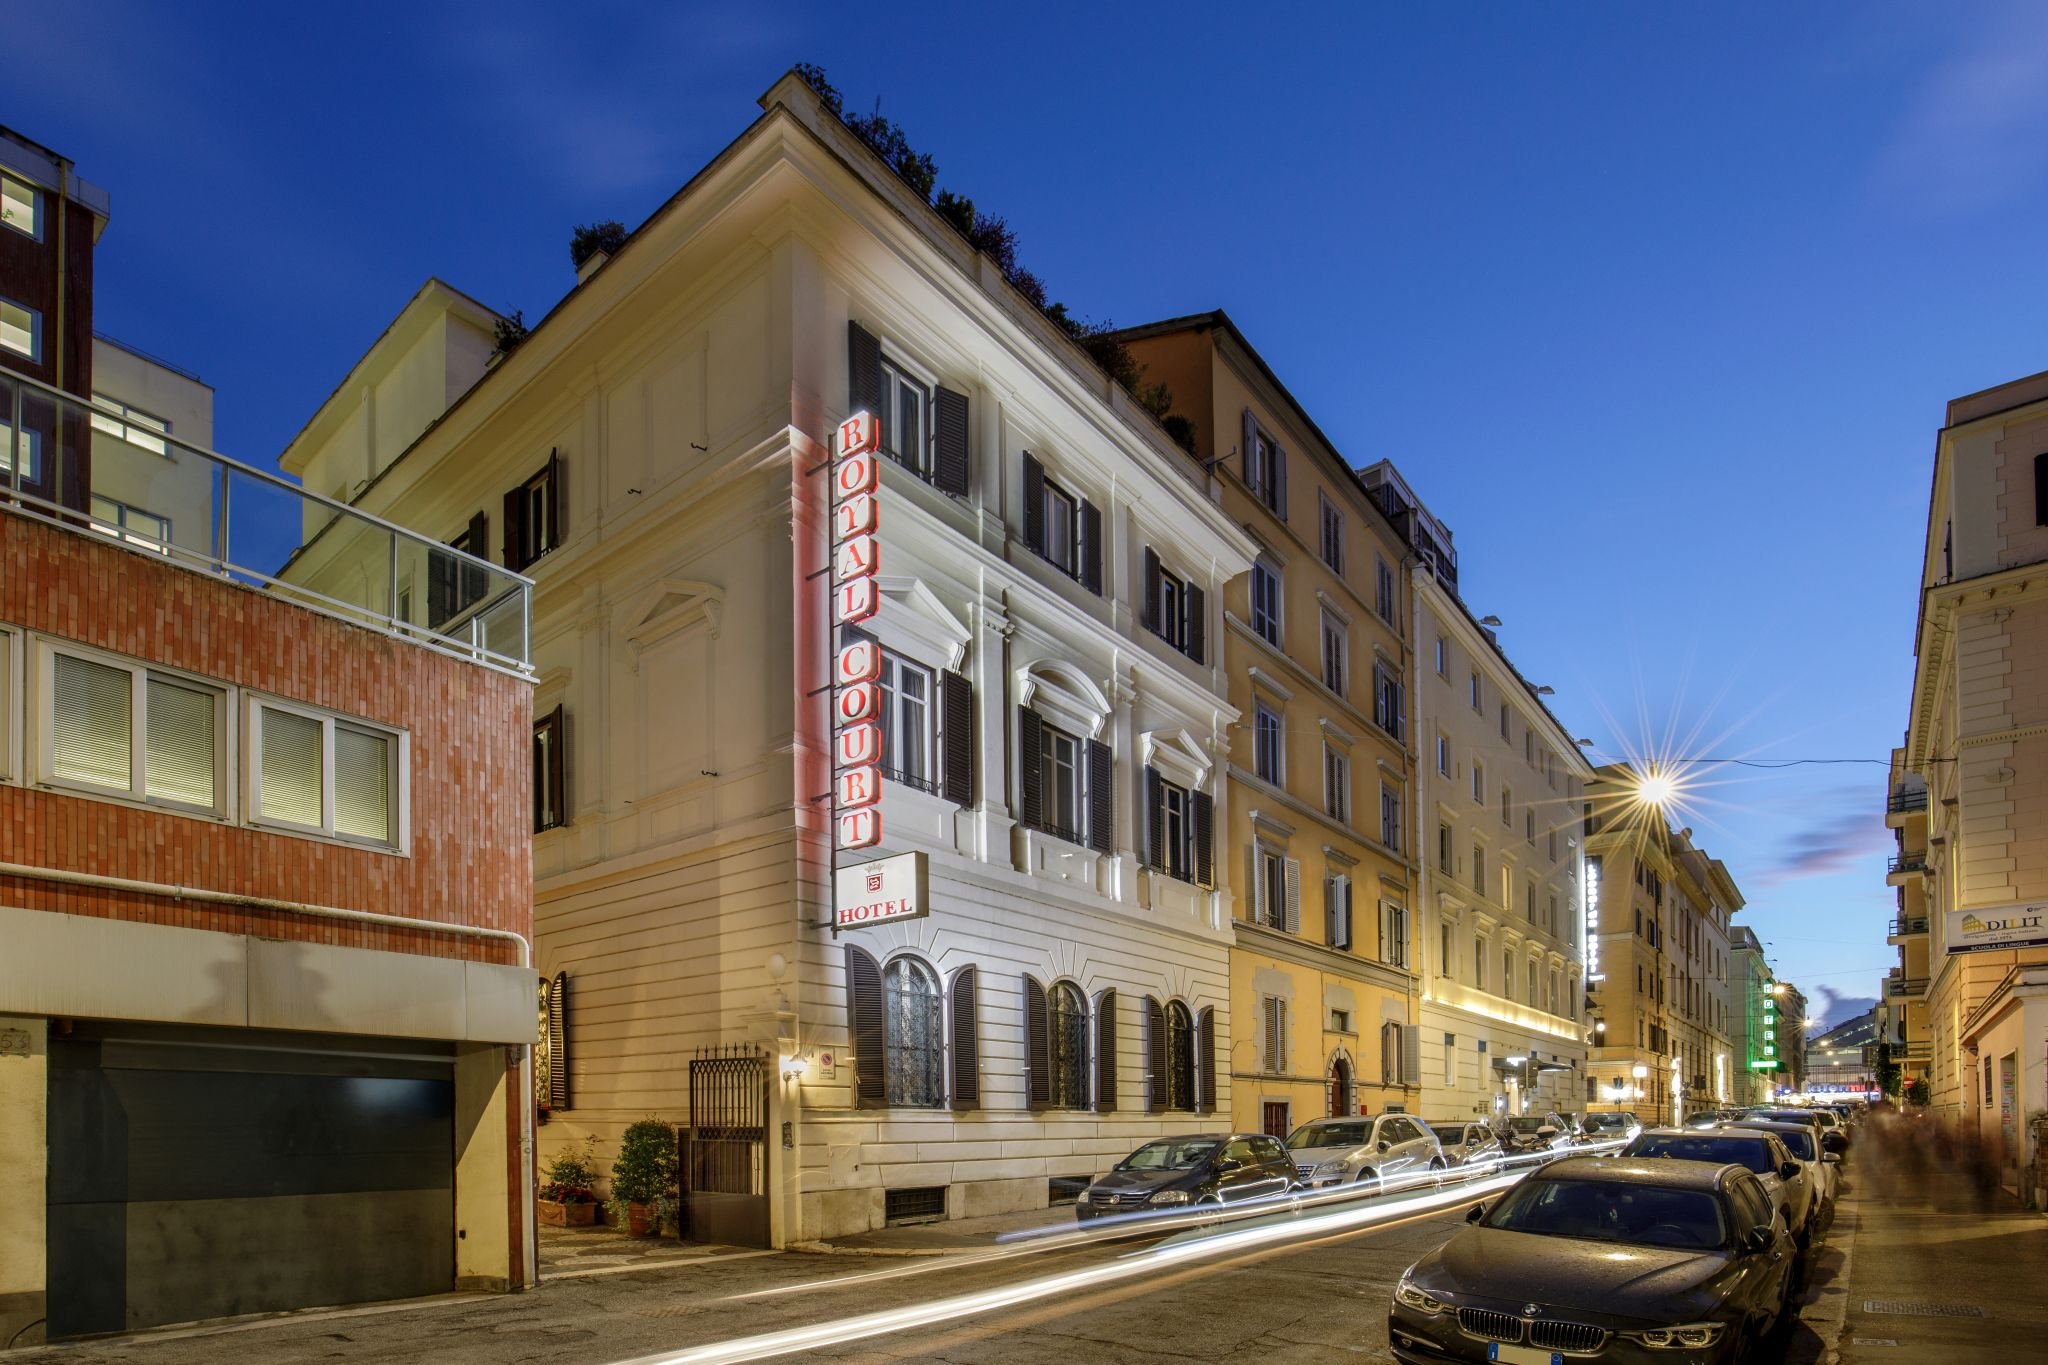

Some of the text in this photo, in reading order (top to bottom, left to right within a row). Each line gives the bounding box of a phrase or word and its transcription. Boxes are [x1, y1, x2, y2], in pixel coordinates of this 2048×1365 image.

[841, 418, 870, 843] ROYAL COURT
[839, 898, 912, 924] HOTEL
[1765, 985, 1773, 1054] HOTEL
